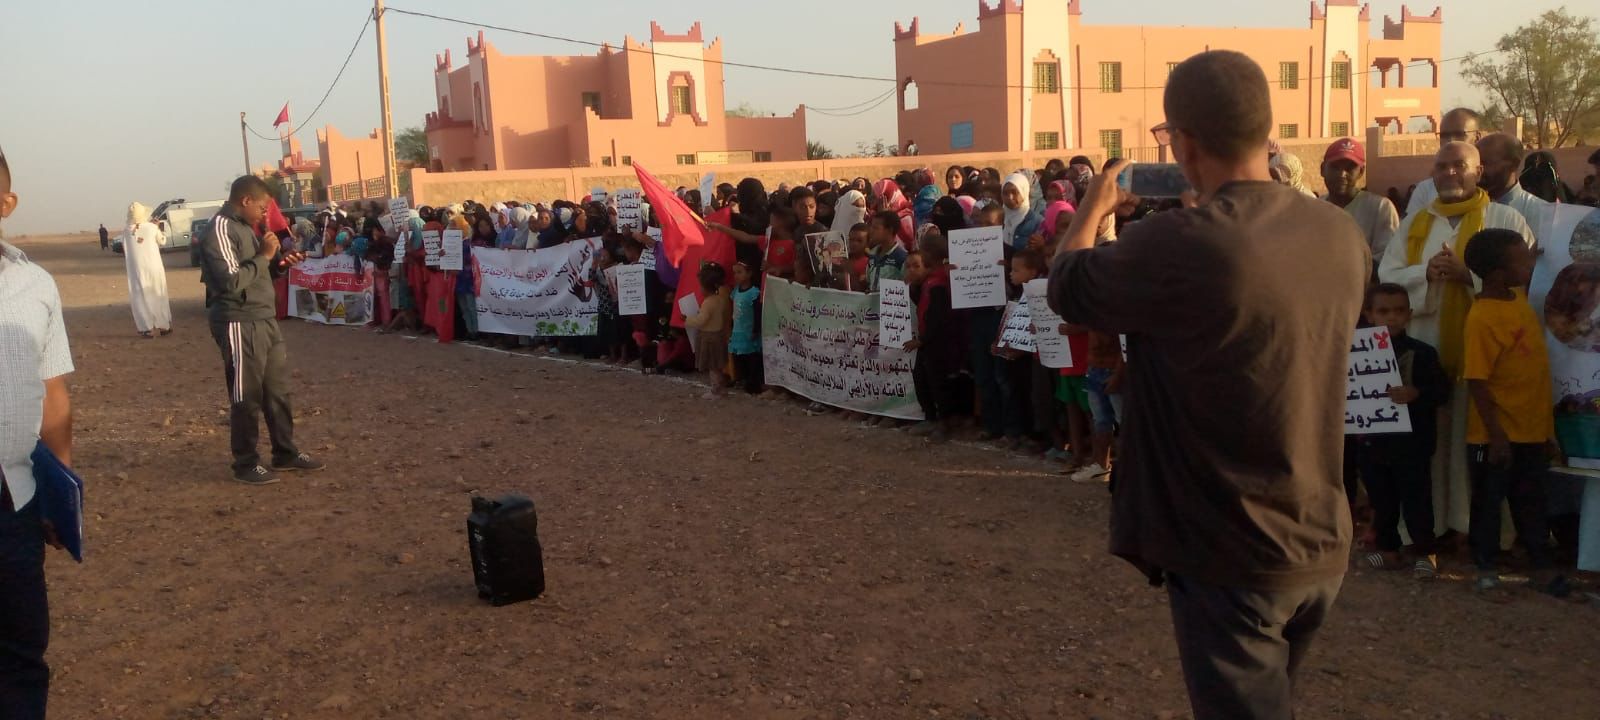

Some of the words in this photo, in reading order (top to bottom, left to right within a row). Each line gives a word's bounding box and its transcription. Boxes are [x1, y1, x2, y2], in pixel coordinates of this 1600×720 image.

[616, 192, 634, 202] المطرح
[616, 202, 640, 212] النفايات
[884, 288, 895, 297] مطرح
[1350, 337, 1374, 353] الم
[1373, 331, 1390, 350] لا
[1347, 358, 1397, 383] النفاي
